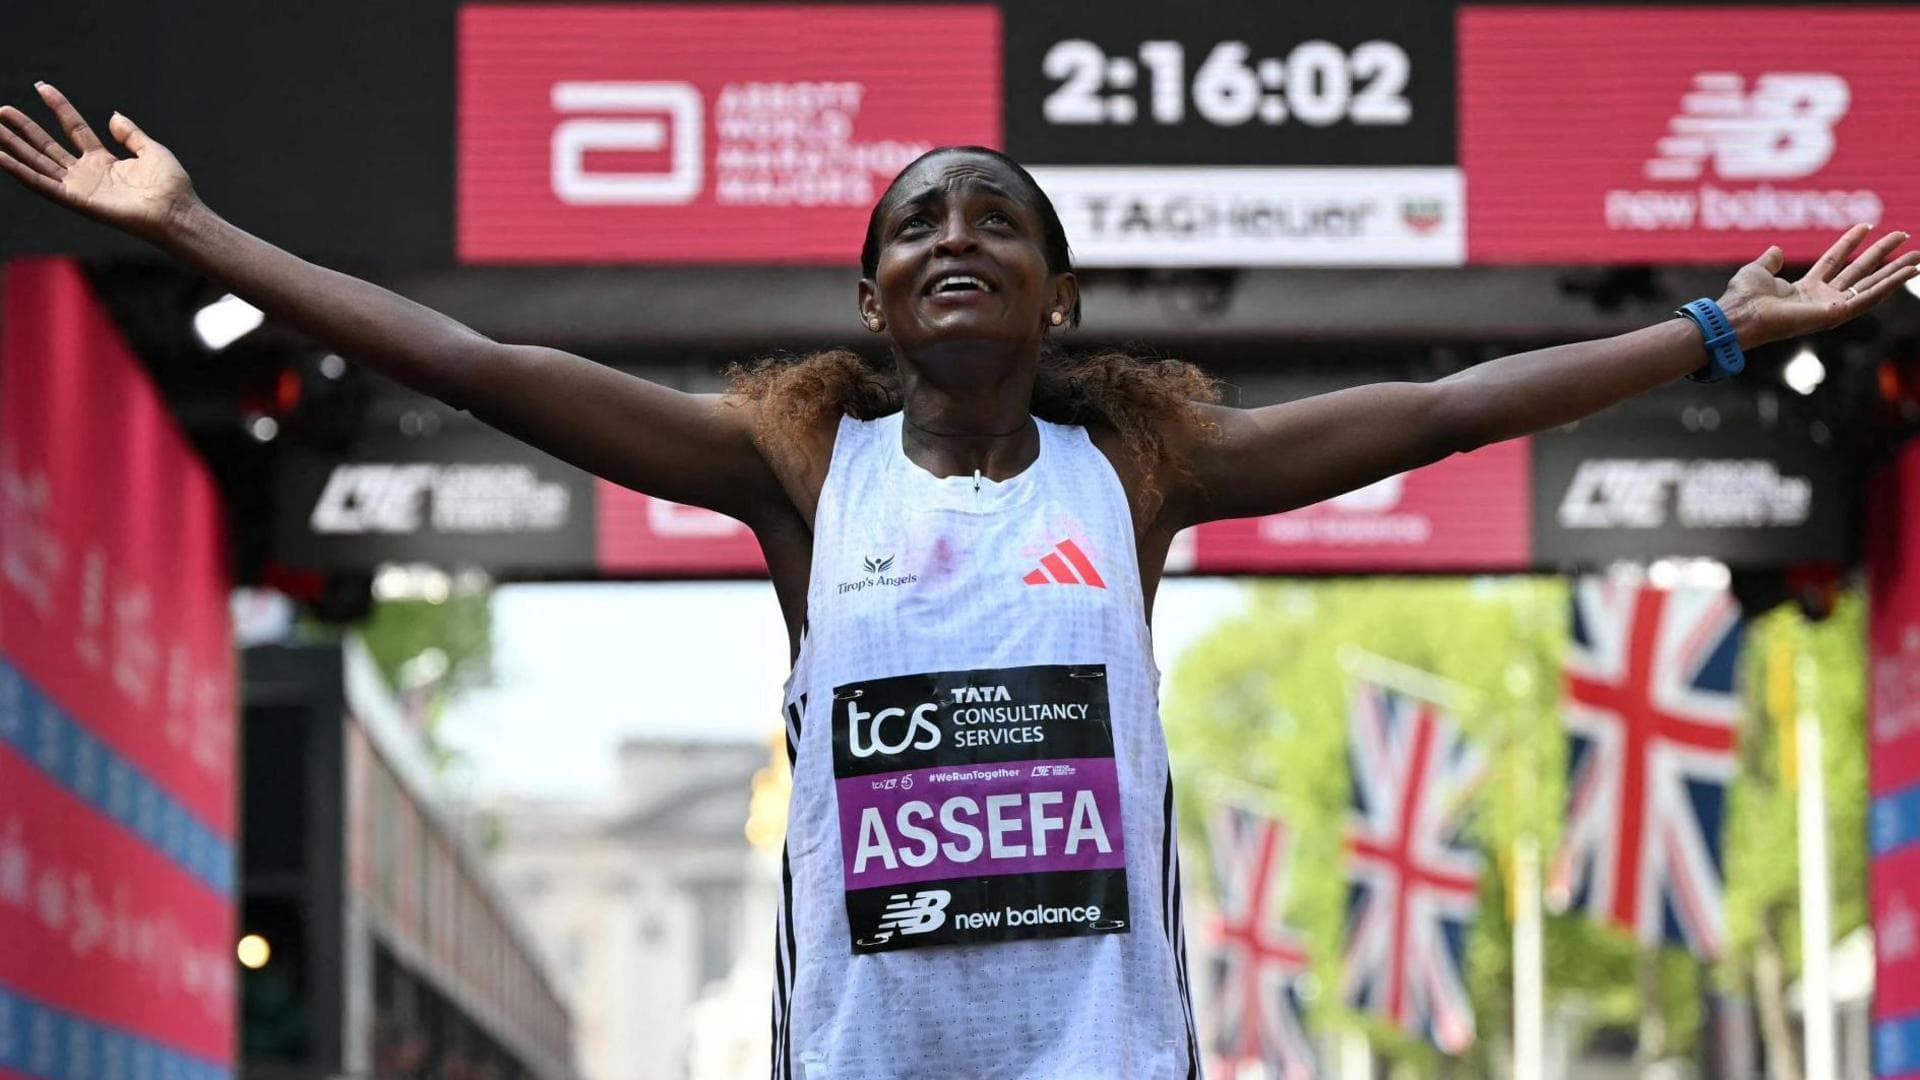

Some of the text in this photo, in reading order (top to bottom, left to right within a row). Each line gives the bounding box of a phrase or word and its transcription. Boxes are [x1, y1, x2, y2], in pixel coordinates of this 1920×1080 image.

[1042, 39, 1412, 126] 2:16:02
[718, 83, 864, 112] ABBOTT
[718, 112, 852, 141] WORLD
[718, 173, 872, 206] MAJORS
[1604, 186, 1883, 230] new balance
[838, 573, 917, 594] Tirop's Angels
[951, 686, 1012, 703] TATA
[953, 703, 1089, 725] CONSULTANCY
[848, 701, 942, 757] tcs
[954, 726, 1044, 747] SERVICES
[929, 768, 1020, 783] #WeRunTogether
[853, 790, 1113, 874] ASSEFA
[955, 904, 1101, 930] new balance
